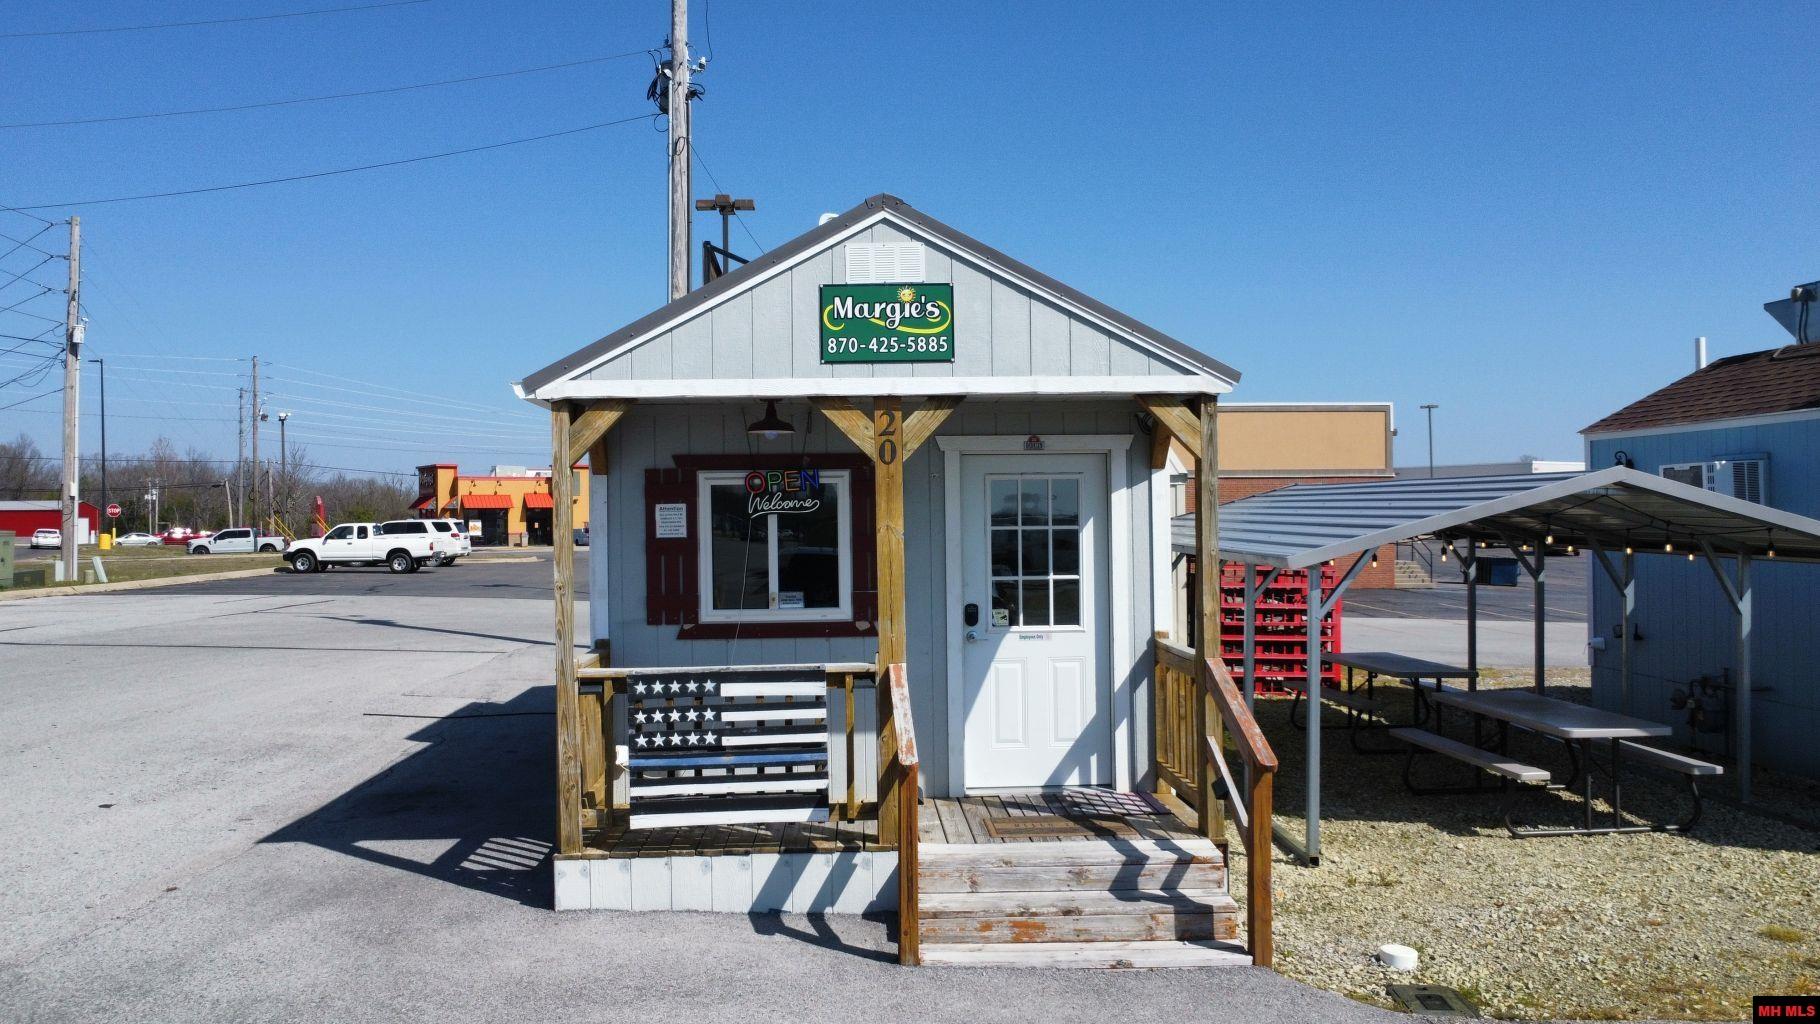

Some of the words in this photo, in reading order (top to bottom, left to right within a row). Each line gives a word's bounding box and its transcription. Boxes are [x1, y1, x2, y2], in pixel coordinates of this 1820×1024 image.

[833, 296, 940, 329] Margie's
[827, 337, 948, 353] 870-425-5885
[745, 469, 819, 494] OPEN
[748, 492, 820, 518] Welcome
